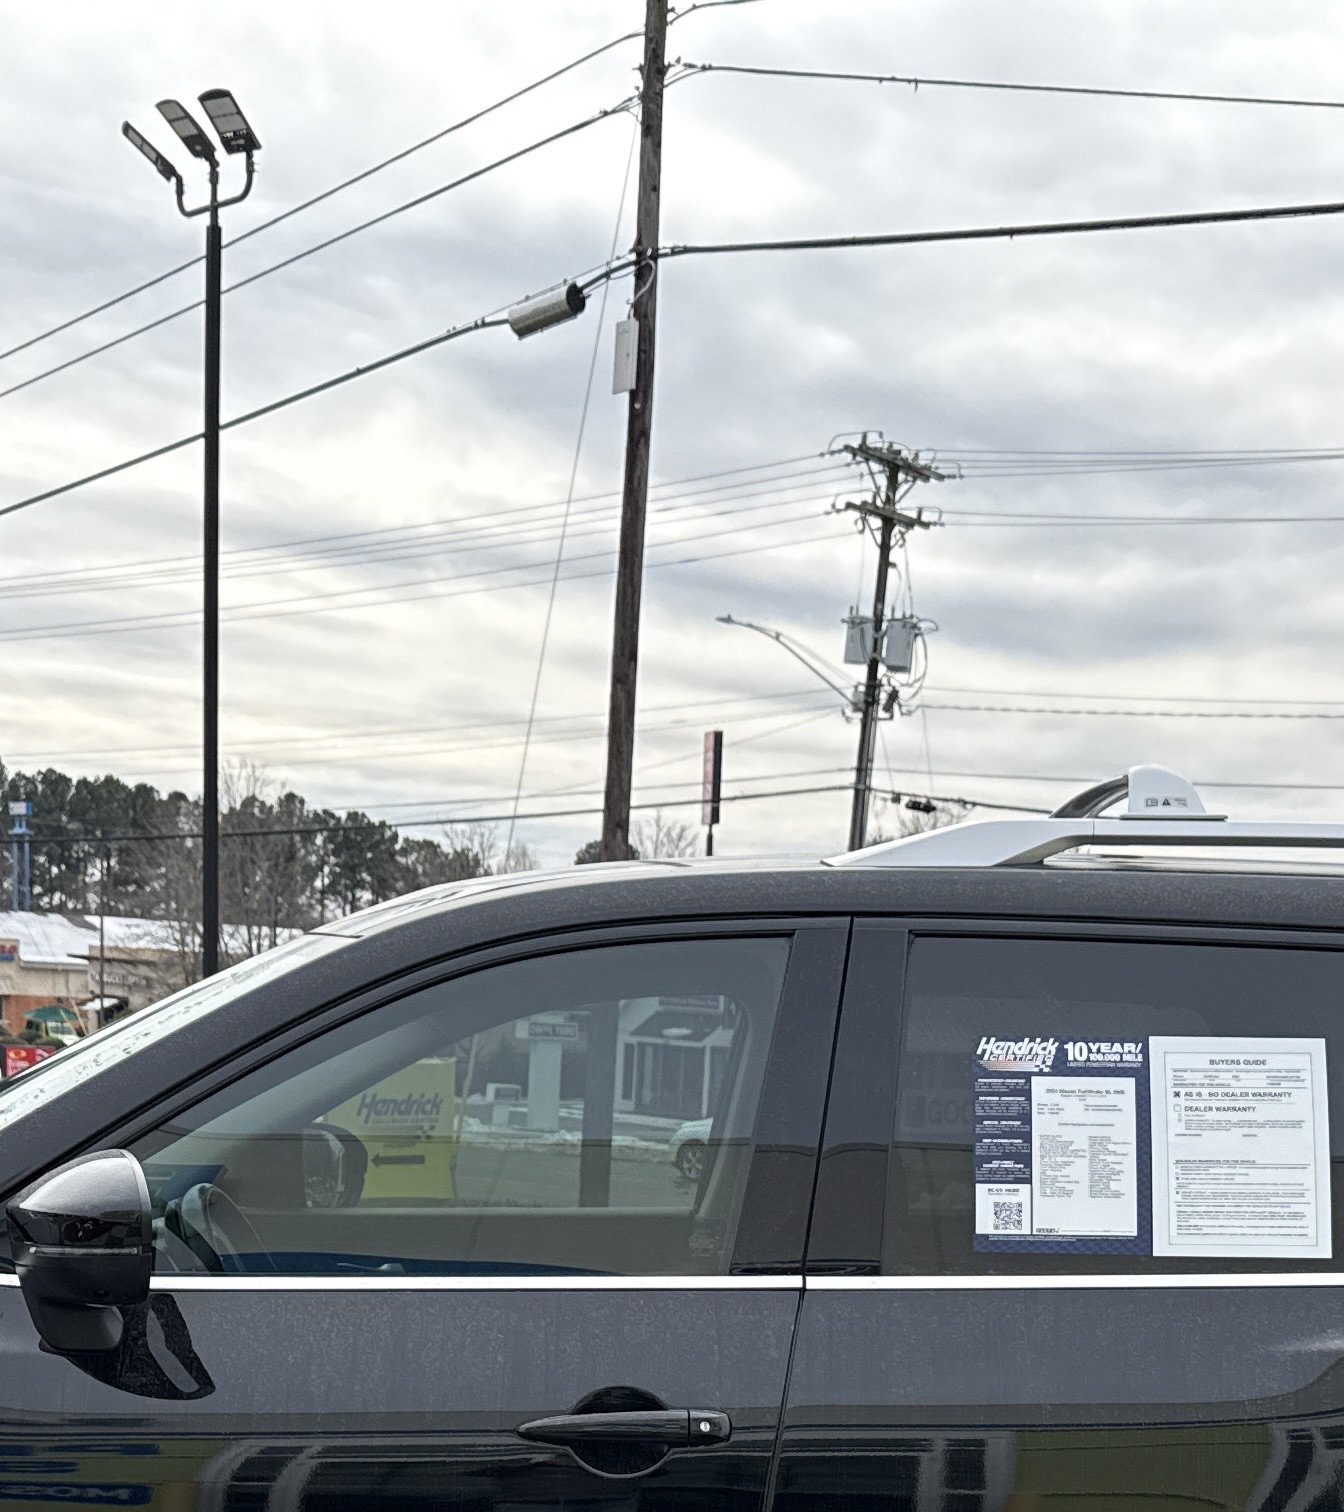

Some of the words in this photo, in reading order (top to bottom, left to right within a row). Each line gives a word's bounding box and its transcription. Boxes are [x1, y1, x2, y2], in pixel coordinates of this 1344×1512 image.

[976, 1037, 1059, 1061] Hendrick
[1064, 1042, 1088, 1061] 10
[1088, 1042, 1143, 1053] YEAR/
[356, 1092, 444, 1124] Hendrick
